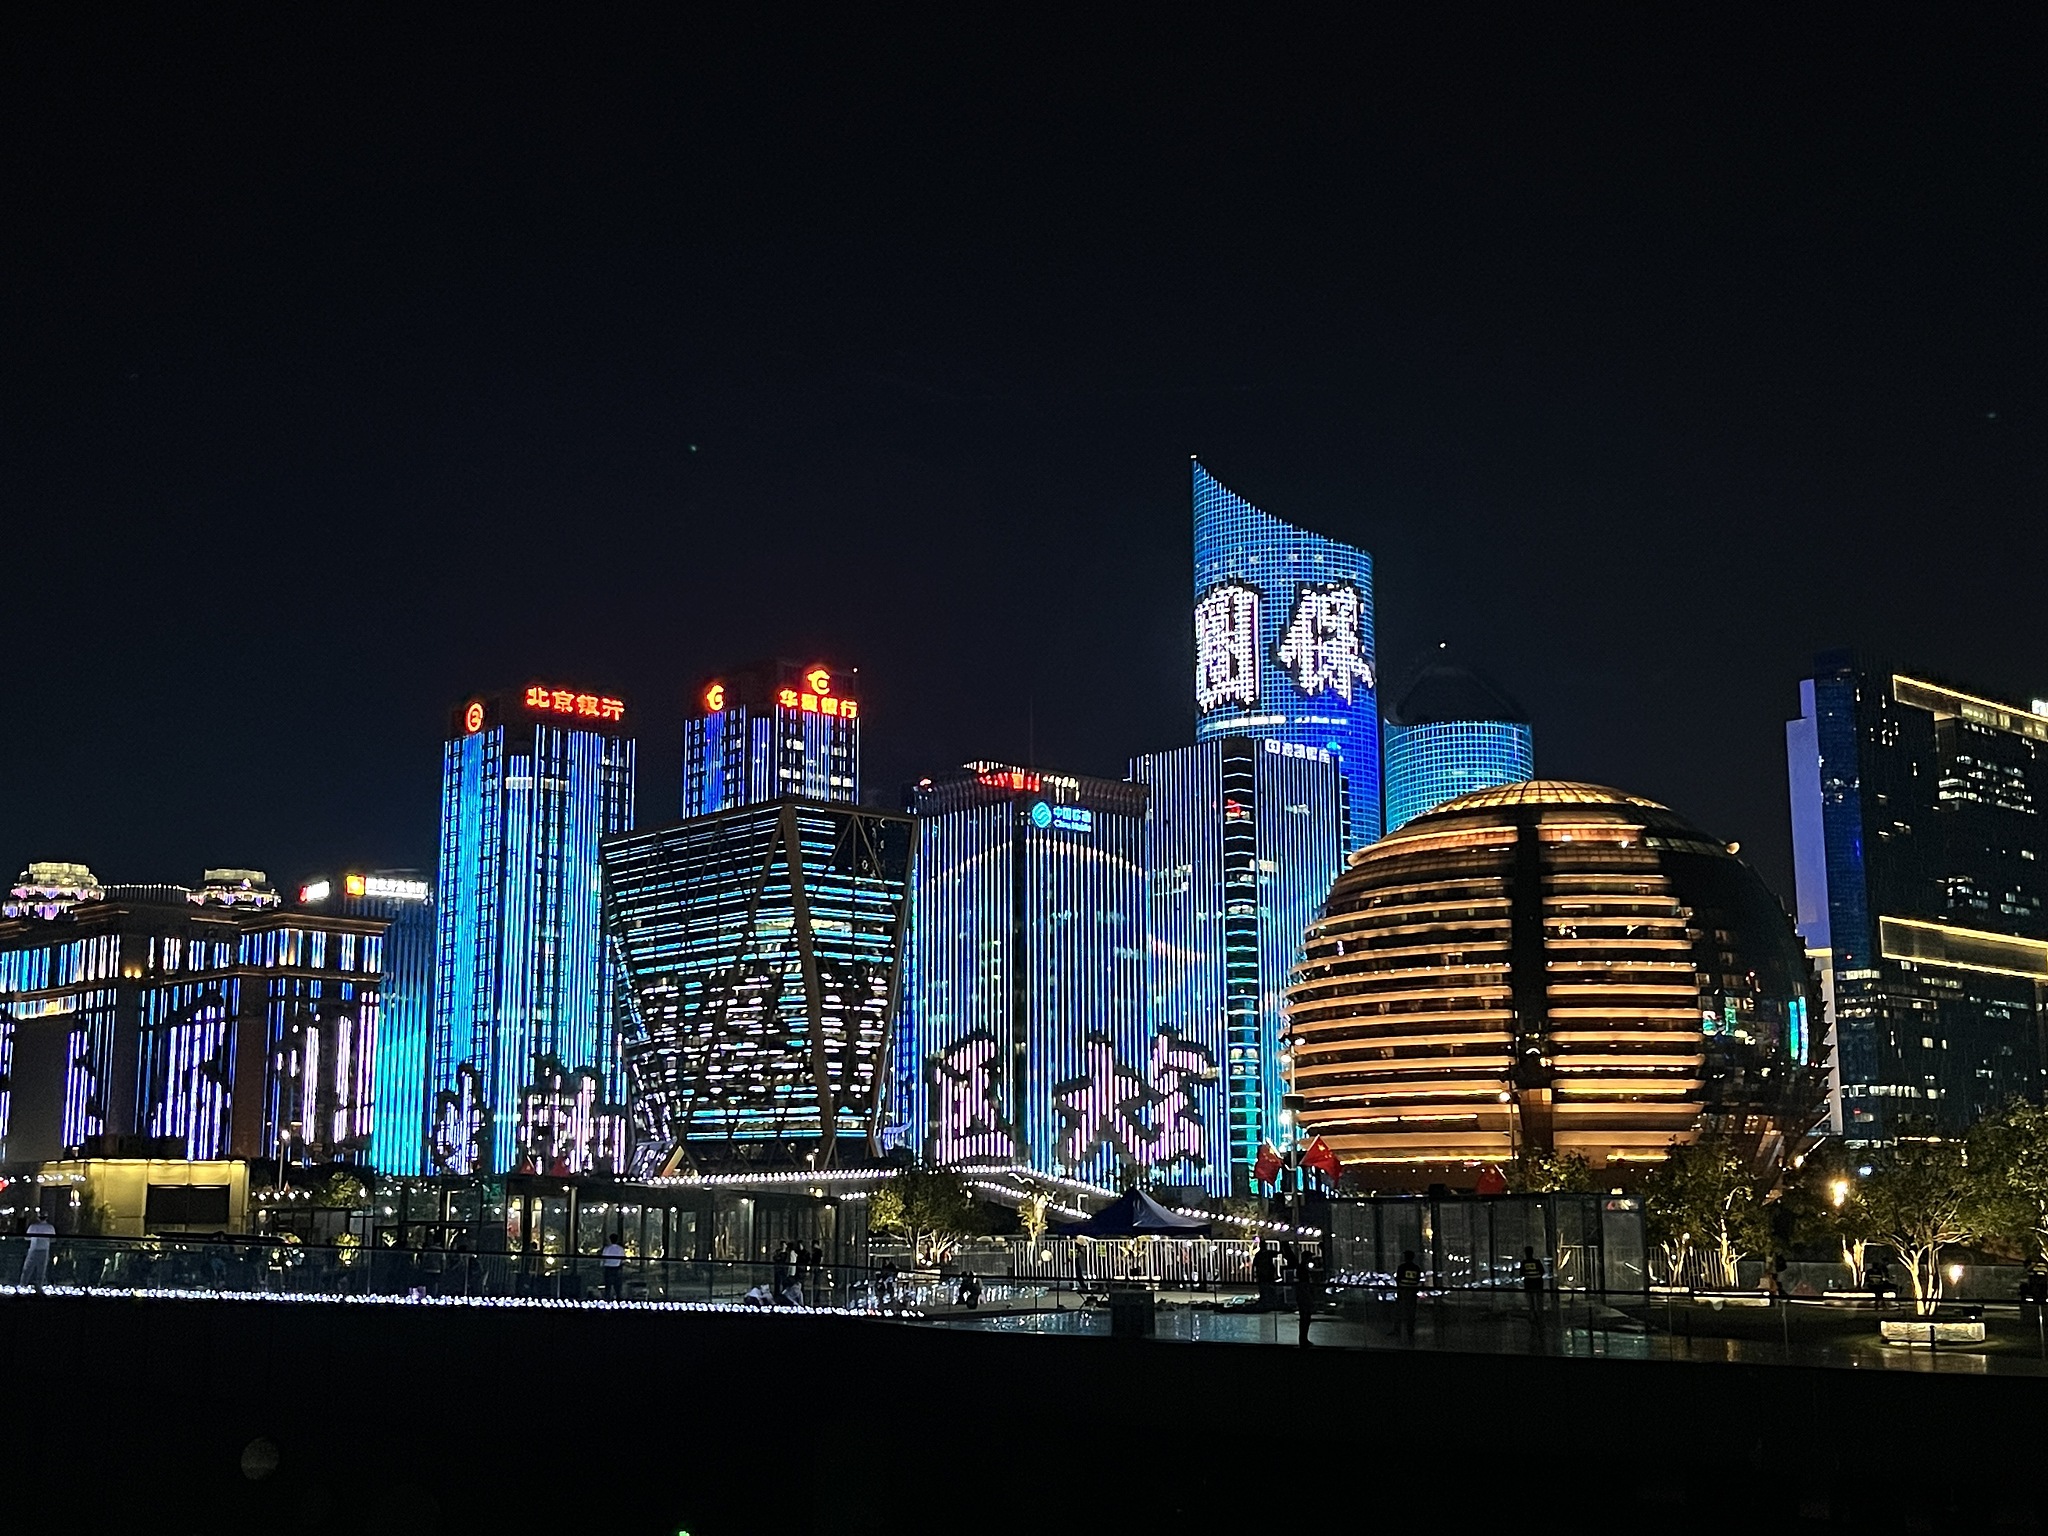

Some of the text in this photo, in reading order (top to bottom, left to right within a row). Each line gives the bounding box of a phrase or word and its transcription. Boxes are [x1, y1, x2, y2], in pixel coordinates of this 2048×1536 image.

[526, 687, 625, 721] 北京银行
[779, 689, 858, 719] 华夏银行
